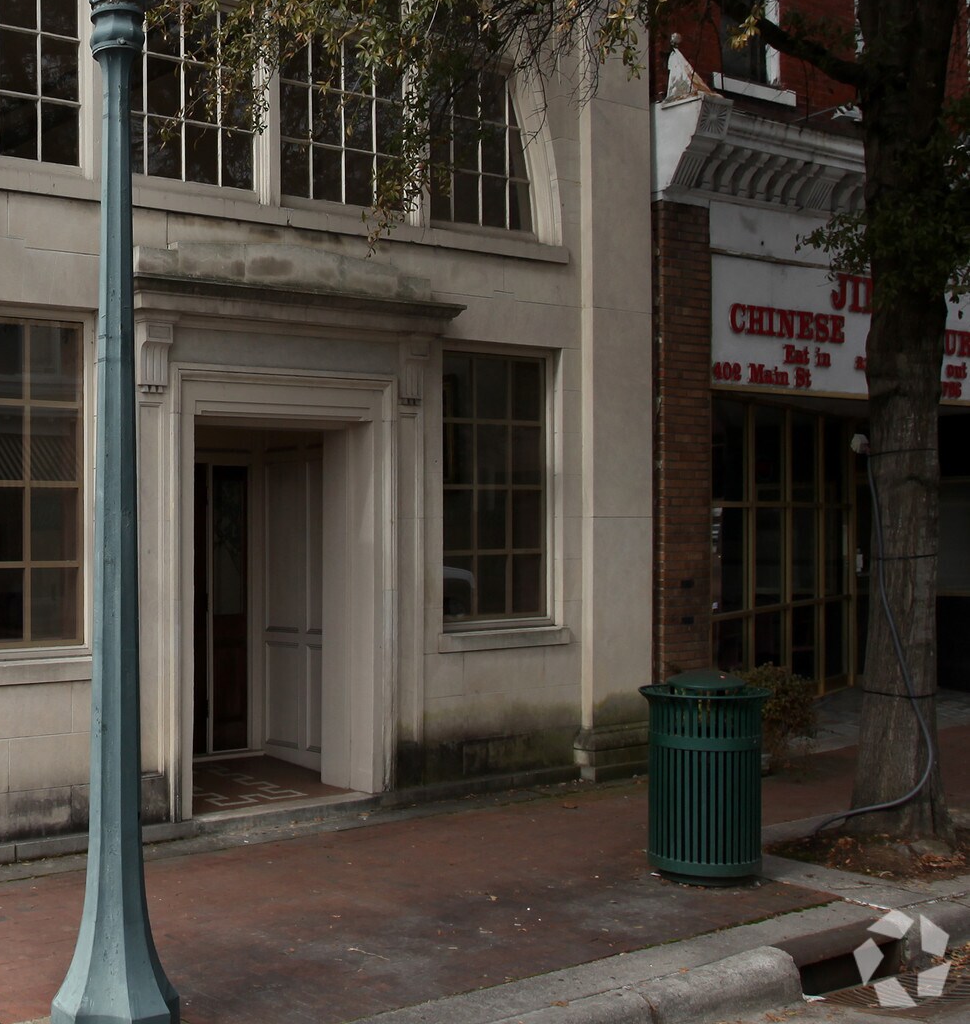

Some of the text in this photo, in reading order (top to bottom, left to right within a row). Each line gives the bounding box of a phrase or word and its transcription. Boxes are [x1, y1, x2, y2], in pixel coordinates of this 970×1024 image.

[729, 302, 845, 344] CHINESE
[783, 344, 810, 365] Eat
[815, 347, 831, 367] in
[748, 363, 790, 386] Main
[794, 367, 812, 388] St
